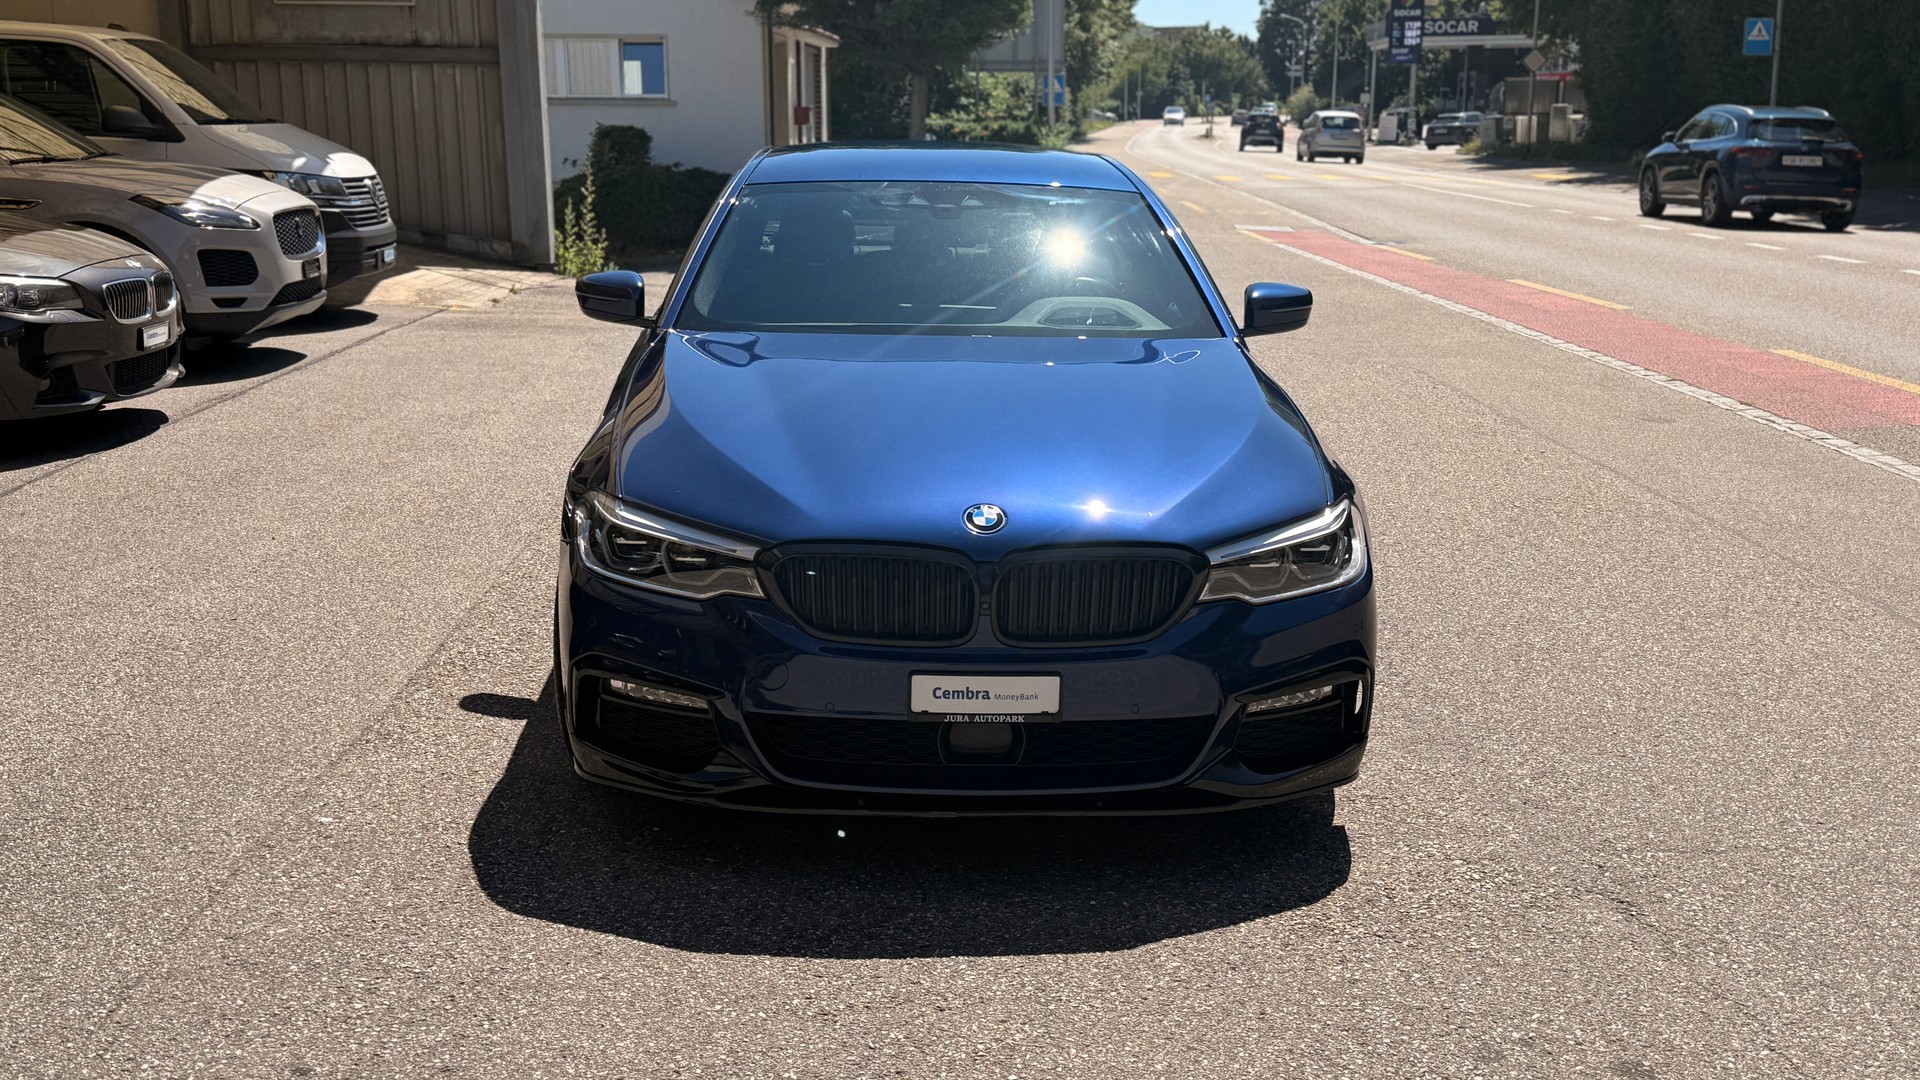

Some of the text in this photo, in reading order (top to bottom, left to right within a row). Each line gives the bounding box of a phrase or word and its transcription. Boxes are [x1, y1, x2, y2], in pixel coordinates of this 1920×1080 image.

[1393, 9, 1421, 17] SOCAR
[1423, 20, 1479, 34] SOCAR
[932, 686, 1039, 702] Cembra MoneyBank
[973, 715, 1025, 723] AUTOPARK
